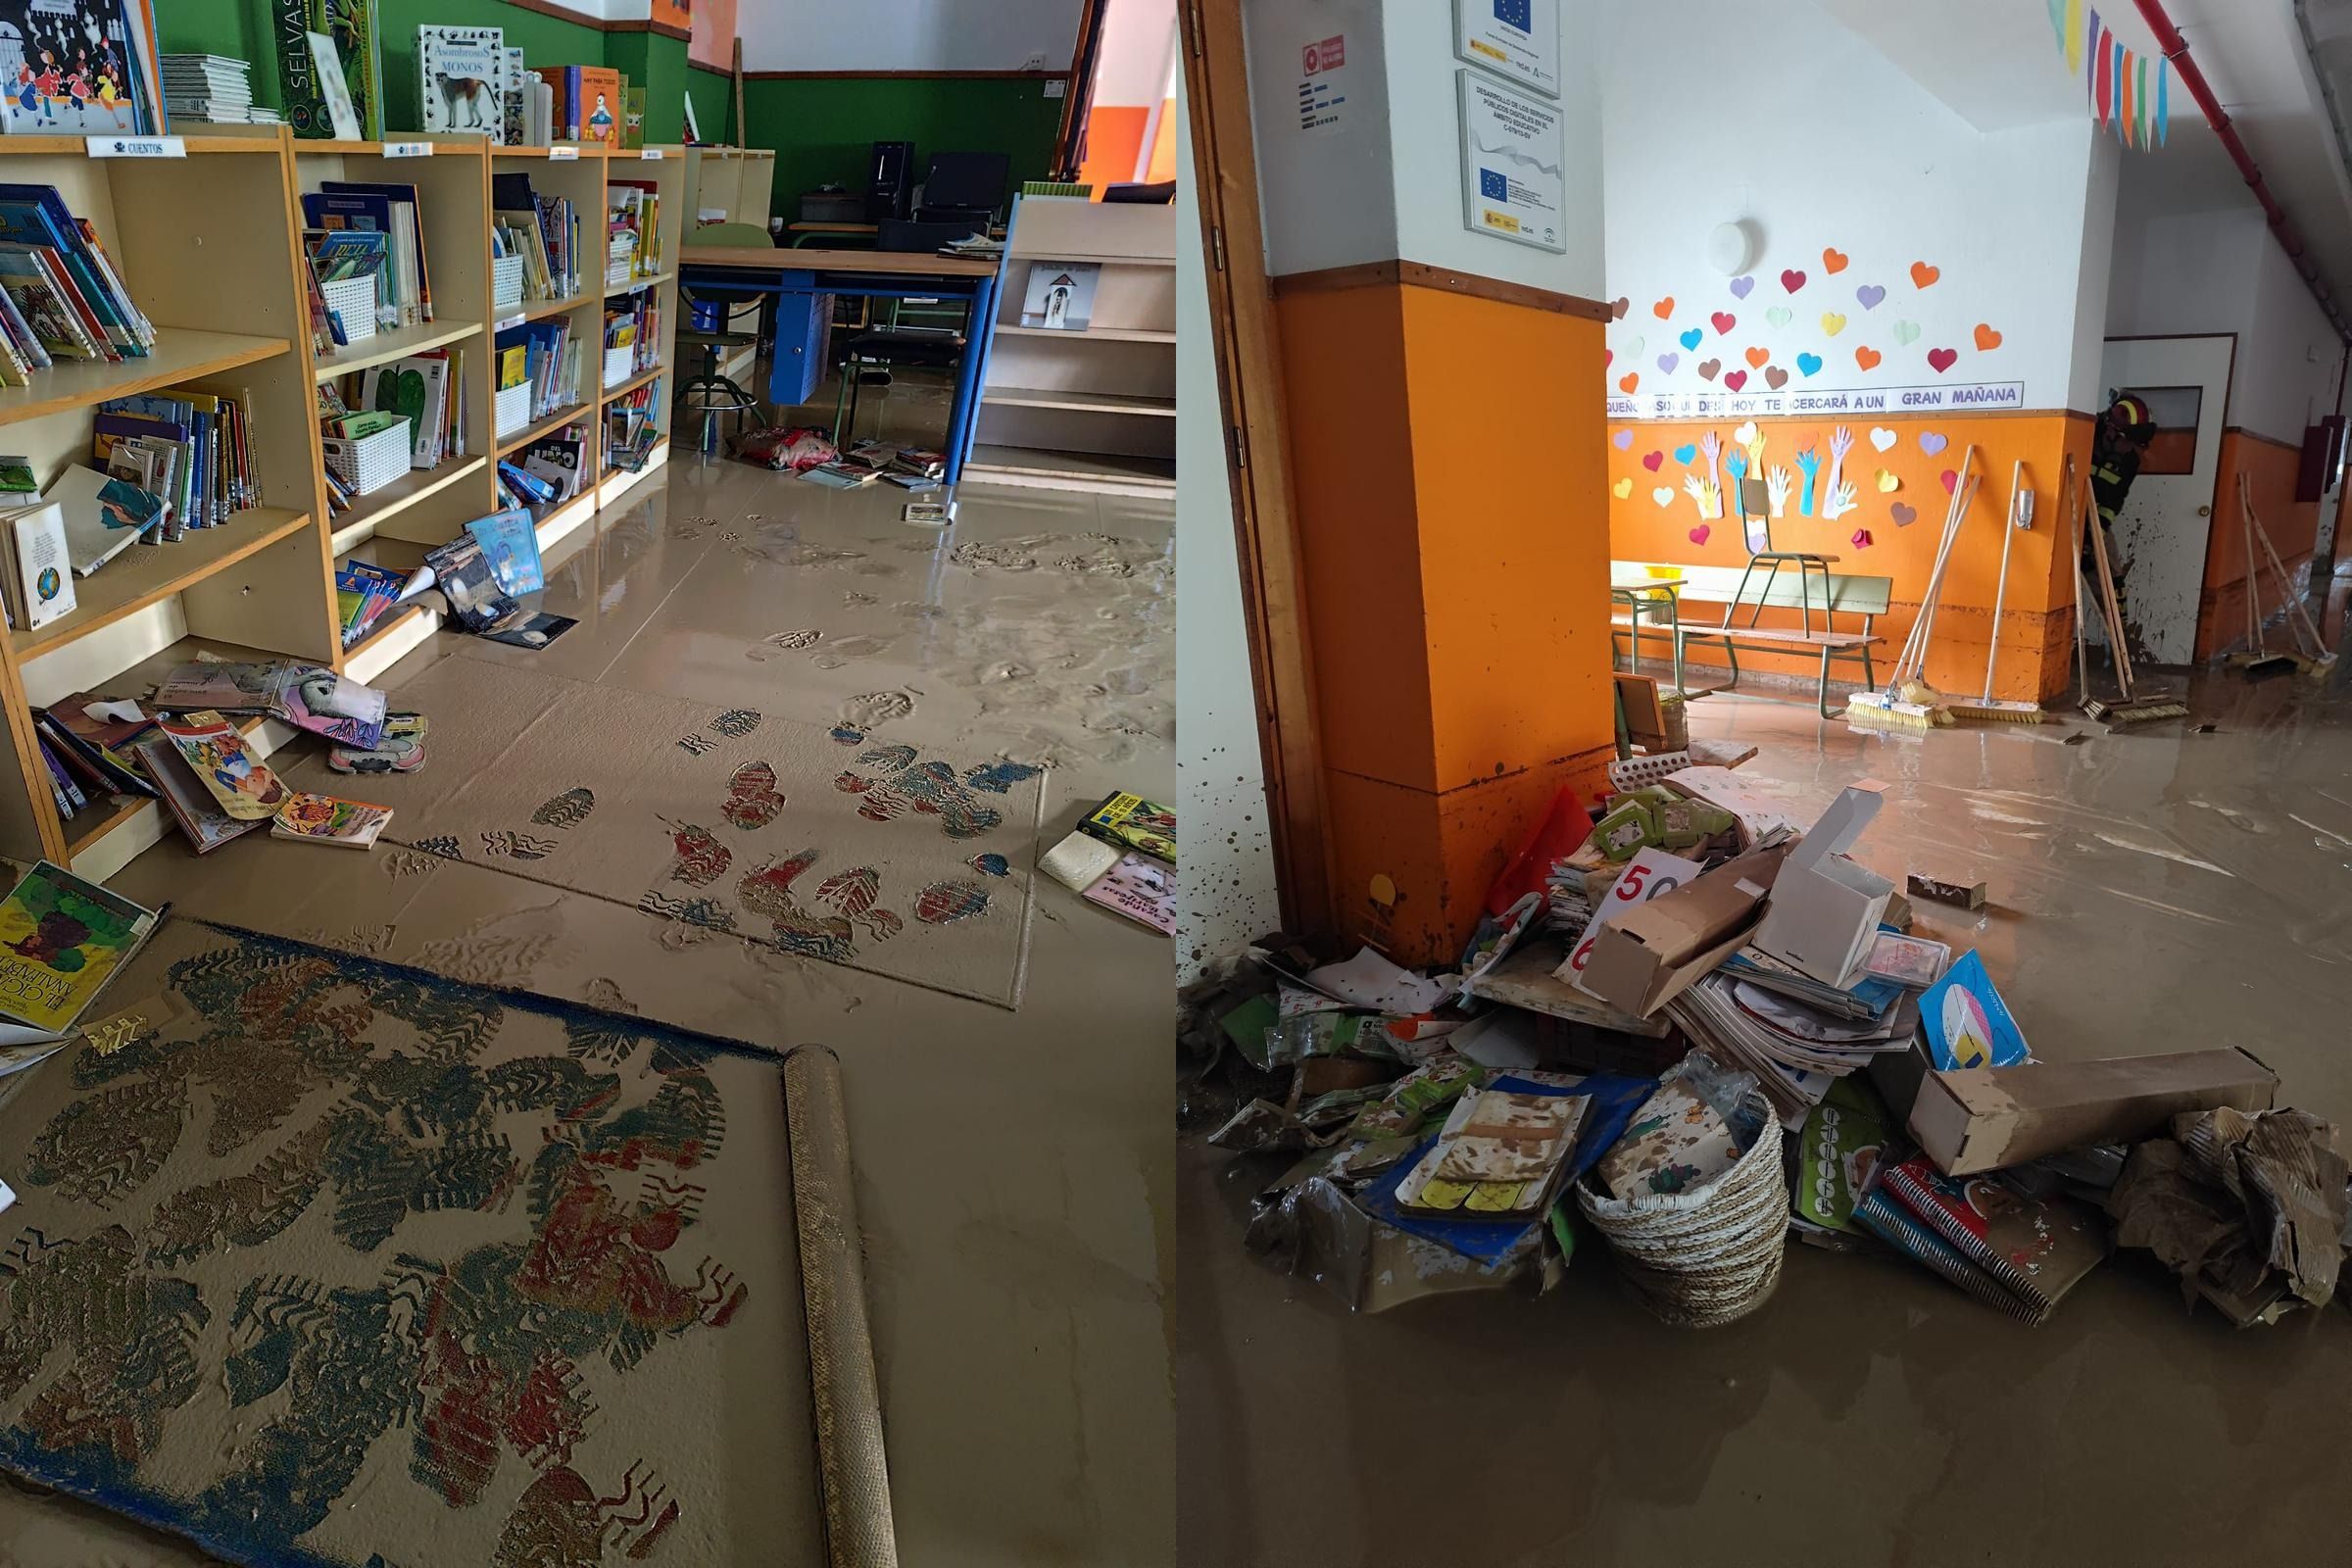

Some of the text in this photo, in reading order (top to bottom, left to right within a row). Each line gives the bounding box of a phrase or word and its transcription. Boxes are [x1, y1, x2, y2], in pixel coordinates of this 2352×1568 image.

[442, 61, 484, 73] MONOS
[1509, 109, 1535, 124] DIGITALES
[1519, 104, 1530, 114] LOS
[1512, 119, 1541, 135] EDUCATIVO
[127, 143, 164, 154] CUENTOS
[1732, 400, 1756, 412] HOY
[1765, 399, 1781, 411] TE
[1789, 393, 1848, 410] CERCARÁ
[1854, 397, 1864, 409] A
[1866, 396, 1885, 409] UN
[1901, 392, 1941, 406] GRAN
[1952, 386, 2017, 403] MAÑANA
[45, 992, 66, 1010] EL
